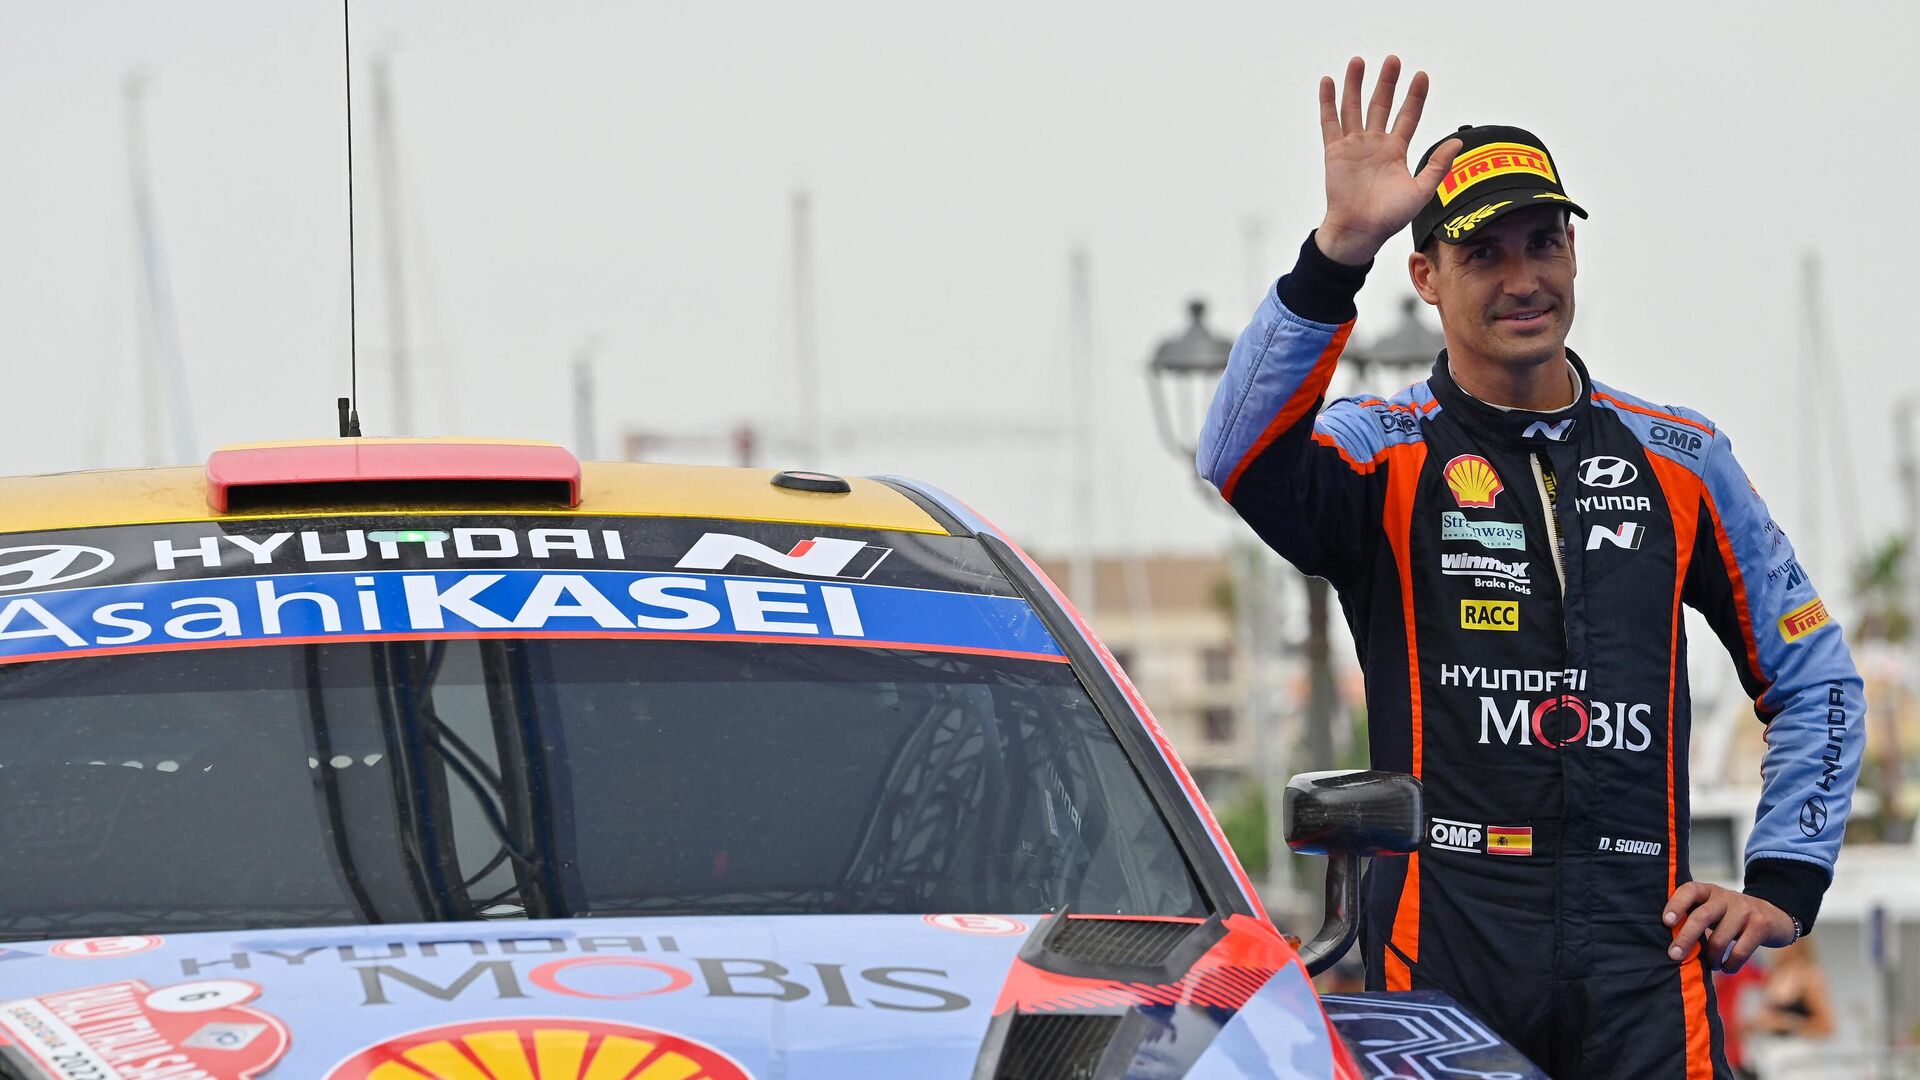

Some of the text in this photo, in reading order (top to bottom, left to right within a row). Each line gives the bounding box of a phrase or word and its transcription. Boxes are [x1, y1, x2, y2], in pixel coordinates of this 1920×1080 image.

[1442, 147, 1549, 194] PIRELLI
[1650, 425, 1702, 452] OMP
[1575, 495, 1651, 514] YUNDA
[153, 527, 626, 571] HYUNDAI
[1474, 577, 1532, 595] Brake Pads
[1464, 605, 1516, 626] RACC
[1441, 663, 1588, 692] HYUNDAI
[1477, 694, 1651, 751] MOBIS
[1816, 679, 1847, 793] HYUNDAI
[1431, 823, 1482, 848] OMP
[179, 934, 680, 977] HYUNDAI
[178, 989, 222, 1002] 6
[348, 954, 972, 1013] MOBIS
